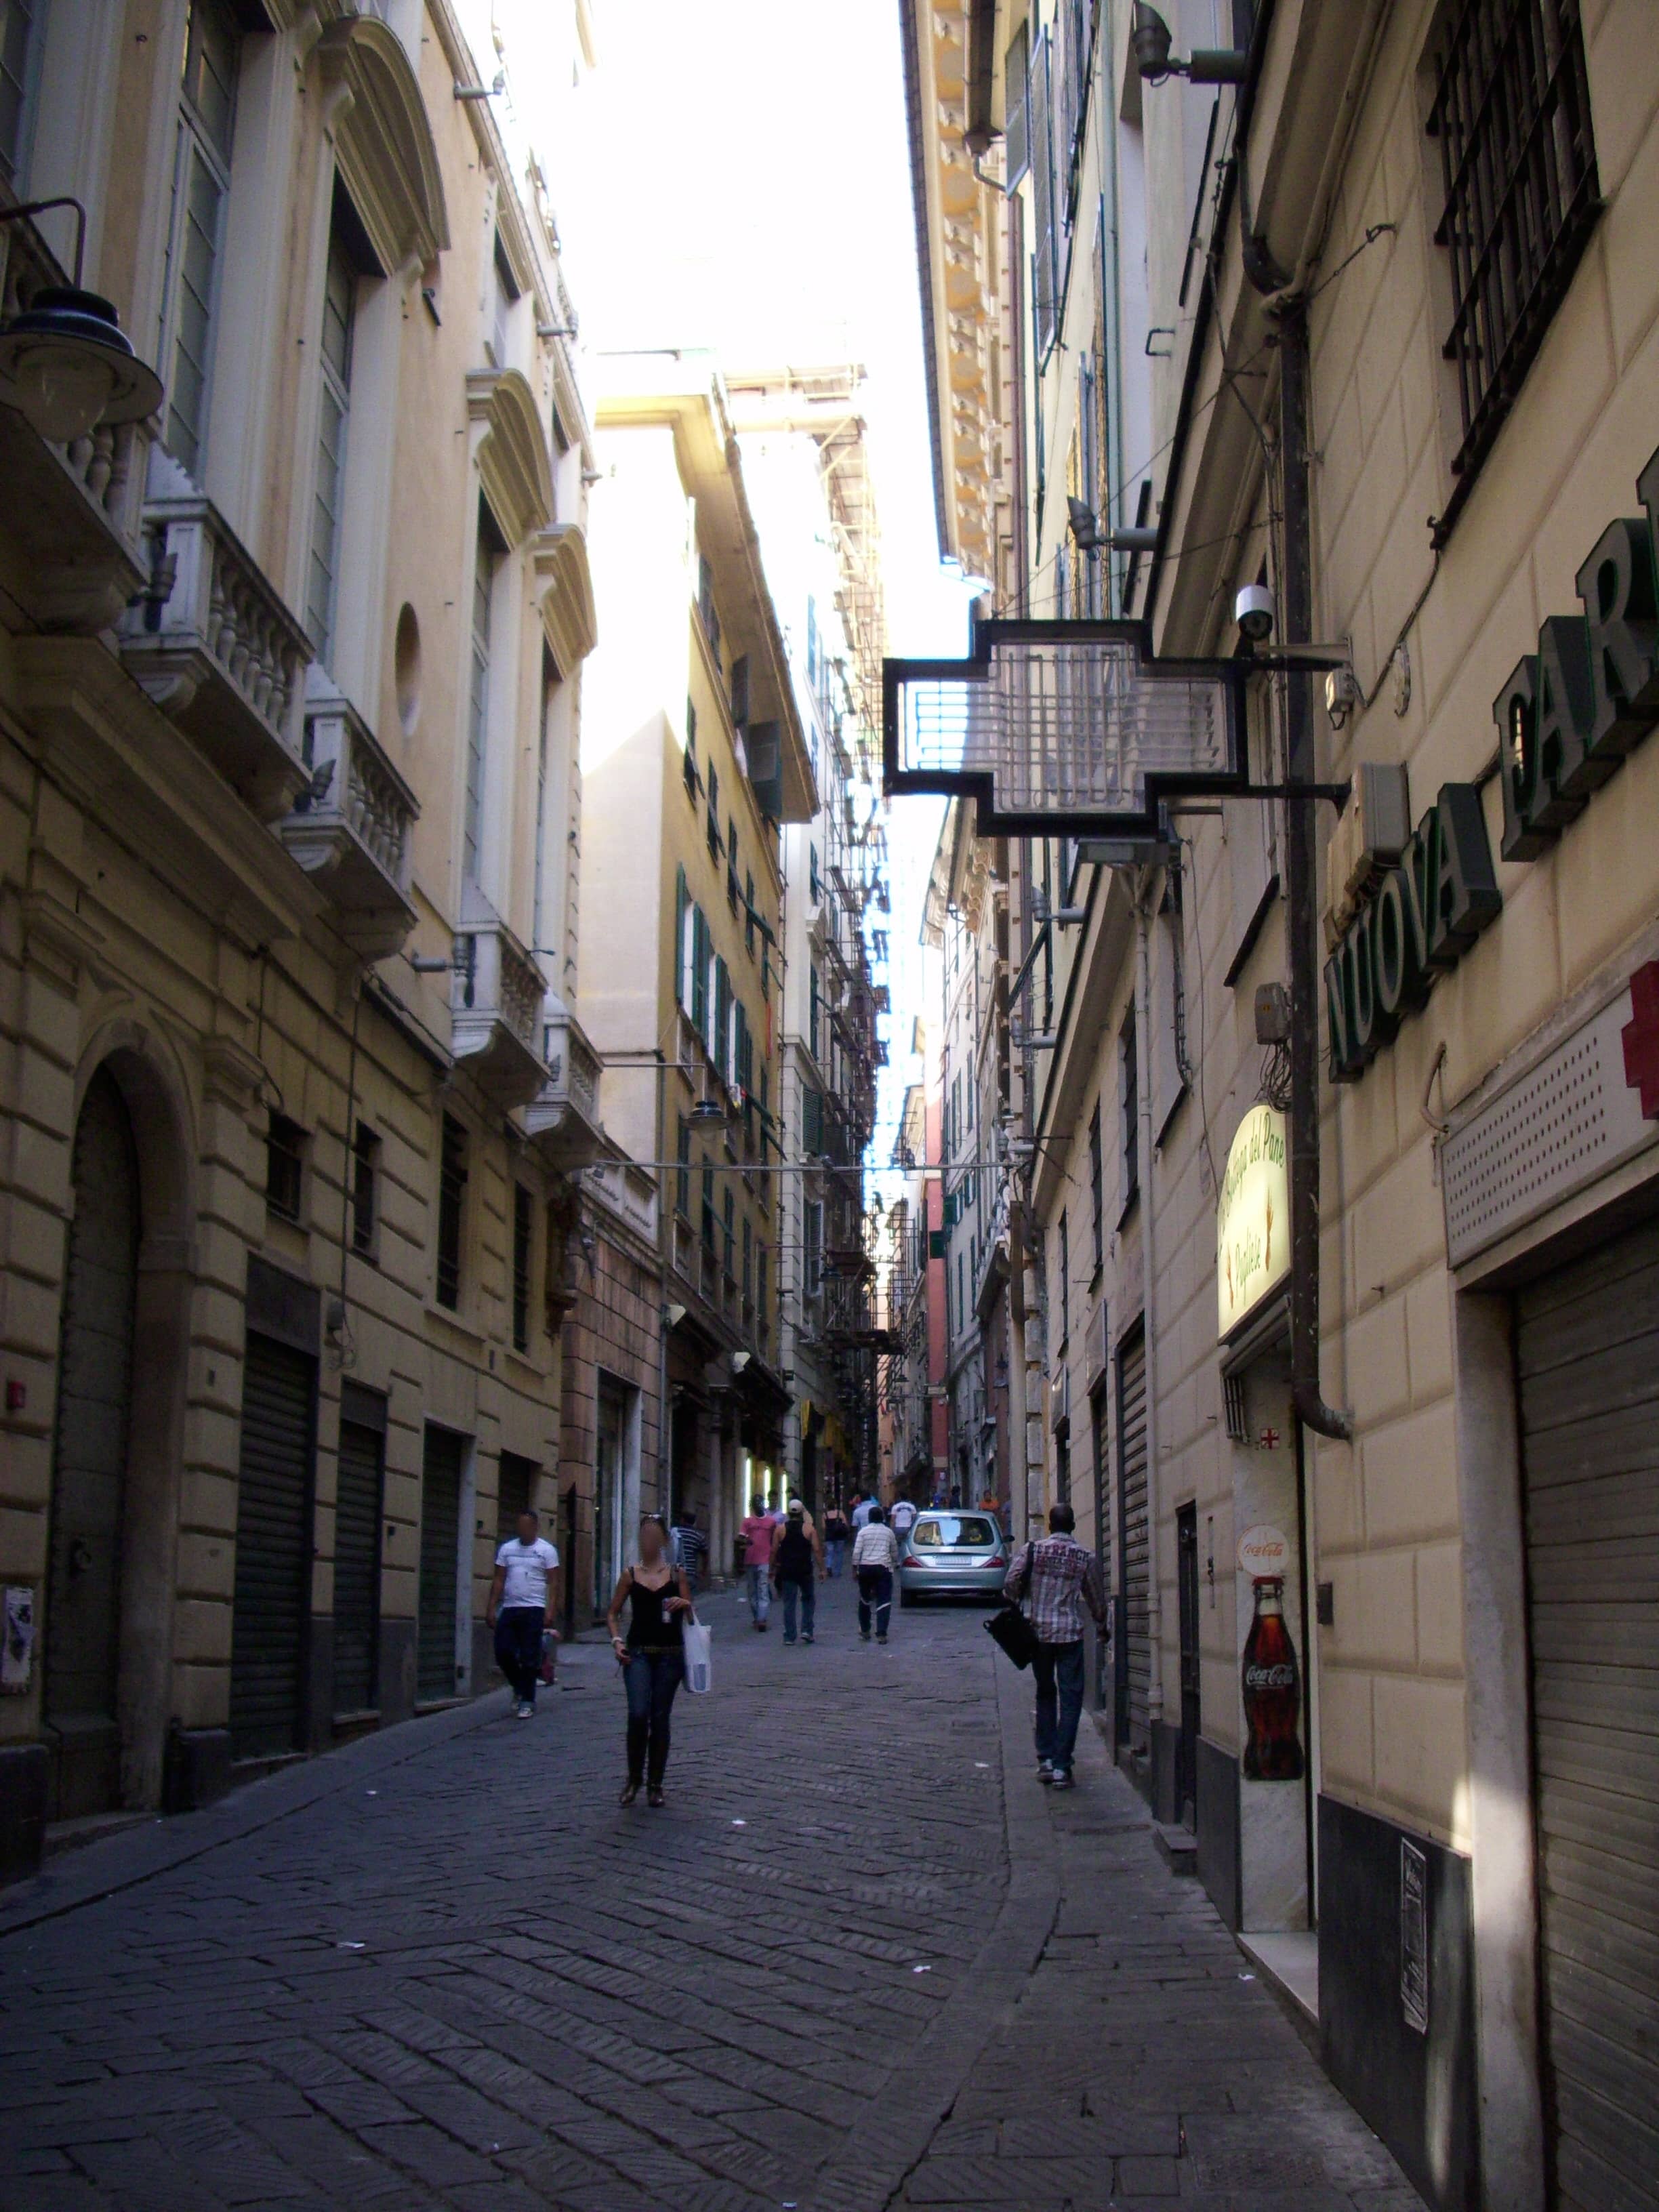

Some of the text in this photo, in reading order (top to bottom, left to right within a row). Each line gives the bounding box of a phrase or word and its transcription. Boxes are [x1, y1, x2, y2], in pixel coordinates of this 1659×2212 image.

[1324, 782, 1502, 1084] NUOVA
[1249, 1112, 1262, 1164] del
[1263, 1111, 1285, 1168] Pane
